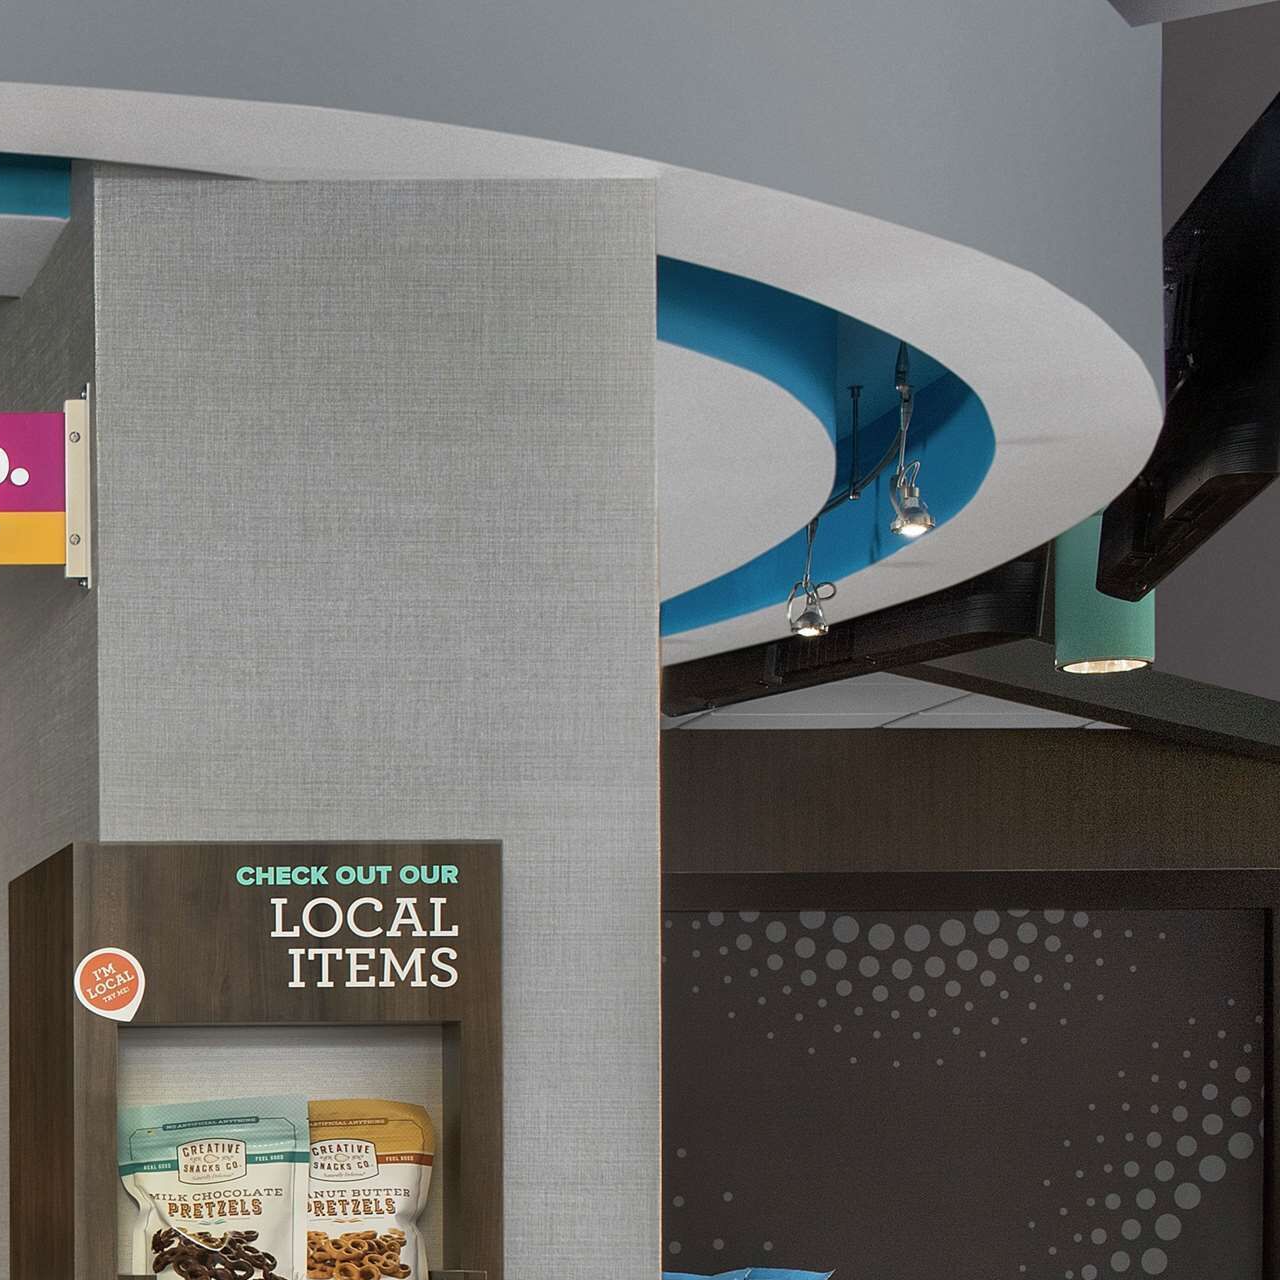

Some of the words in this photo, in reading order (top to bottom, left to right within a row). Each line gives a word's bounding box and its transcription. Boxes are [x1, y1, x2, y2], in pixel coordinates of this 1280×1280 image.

[236, 866, 329, 886] CHECK
[335, 866, 392, 885] OUT
[399, 865, 458, 885] OUR
[270, 896, 459, 938] LOCAL
[92, 963, 117, 981] I'M
[288, 947, 459, 988] ITEMS
[86, 970, 135, 1000] LOCAL
[182, 1143, 240, 1158] CREATIVE
[311, 1144, 370, 1156] CREATIVE
[183, 1164, 220, 1173] SNACKS
[313, 1161, 352, 1171] SNACKS
[149, 1193, 187, 1201] MILK
[192, 1188, 283, 1200] CHOCOLATE
[352, 1188, 410, 1197] BUTTER
[168, 1199, 263, 1218] PRETZELS
